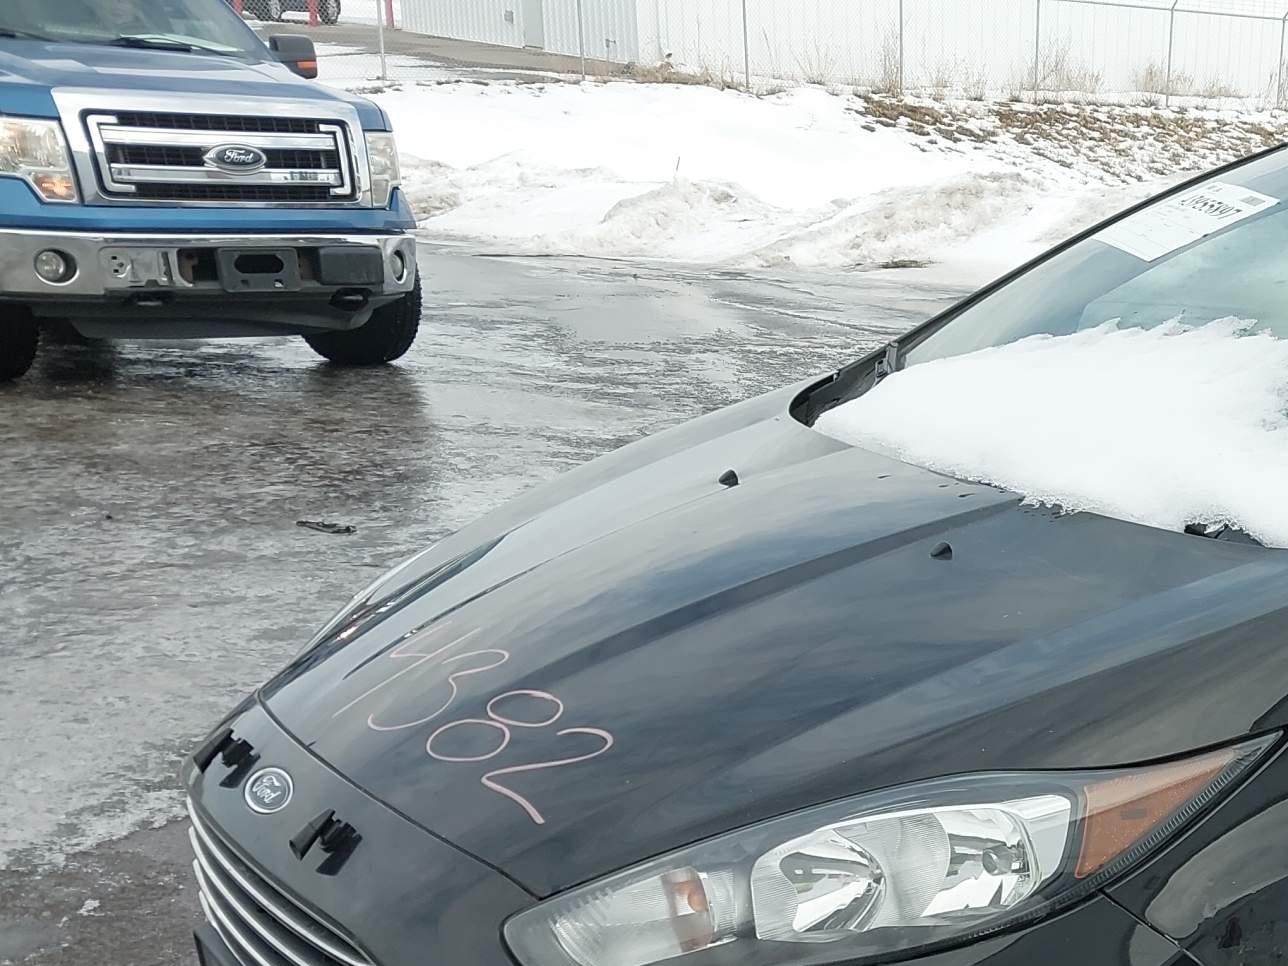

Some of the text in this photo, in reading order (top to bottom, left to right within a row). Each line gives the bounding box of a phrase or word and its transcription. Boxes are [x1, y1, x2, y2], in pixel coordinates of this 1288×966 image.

[224, 149, 255, 163] Ford
[331, 620, 614, 825] 4382
[252, 775, 282, 804] Ford
